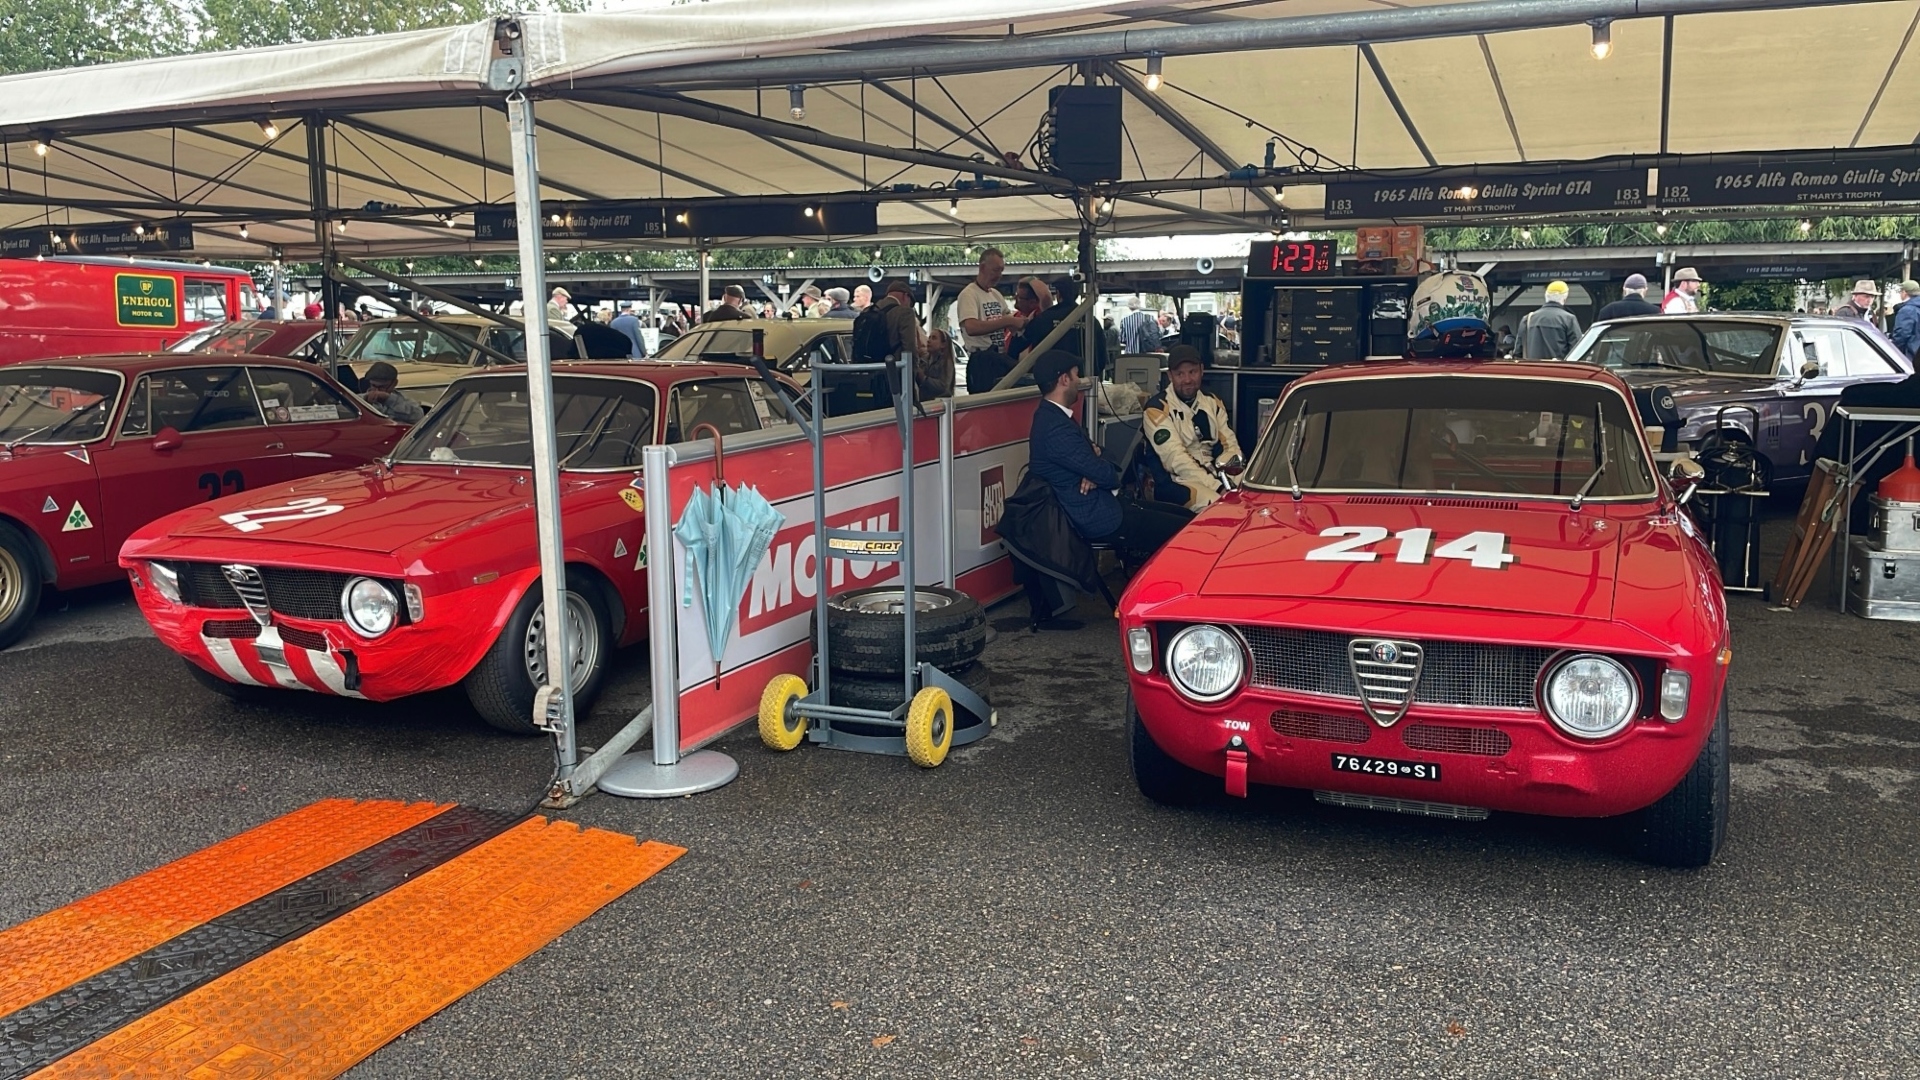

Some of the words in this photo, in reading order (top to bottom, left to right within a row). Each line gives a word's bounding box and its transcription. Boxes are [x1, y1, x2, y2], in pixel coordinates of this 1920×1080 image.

[1715, 174, 1753, 189] 1965
[1755, 171, 1787, 188] Alfa
[1790, 171, 1838, 186] Romeo
[1842, 168, 1886, 185] Giulia
[1373, 189, 1406, 203] 1965
[1408, 186, 1434, 201] Alfa
[1438, 185, 1479, 200] Romeo
[1481, 183, 1519, 199] Giulia
[1521, 182, 1562, 200] Sprint
[1565, 180, 1592, 196] GTA
[1616, 188, 1640, 200] 183
[1664, 185, 1689, 198] 182
[1810, 192, 1843, 200] MARY'S
[1845, 191, 1882, 199] TROPHY
[1331, 199, 1352, 210] 183
[1443, 205, 1452, 213] ST
[1454, 204, 1483, 212] MARY'S
[1485, 203, 1516, 211] TROPHY
[503, 218, 517, 228] 196
[589, 215, 612, 229] Sprint
[645, 222, 660, 231] 185
[1272, 244, 1315, 272] 1:23
[142, 282, 152, 291] BP
[122, 295, 172, 308] ENERGOL
[131, 310, 153, 318] MOTOR
[1305, 526, 1514, 569] 214
[1224, 719, 1250, 732] TOW
[1336, 755, 1398, 775] 76429
